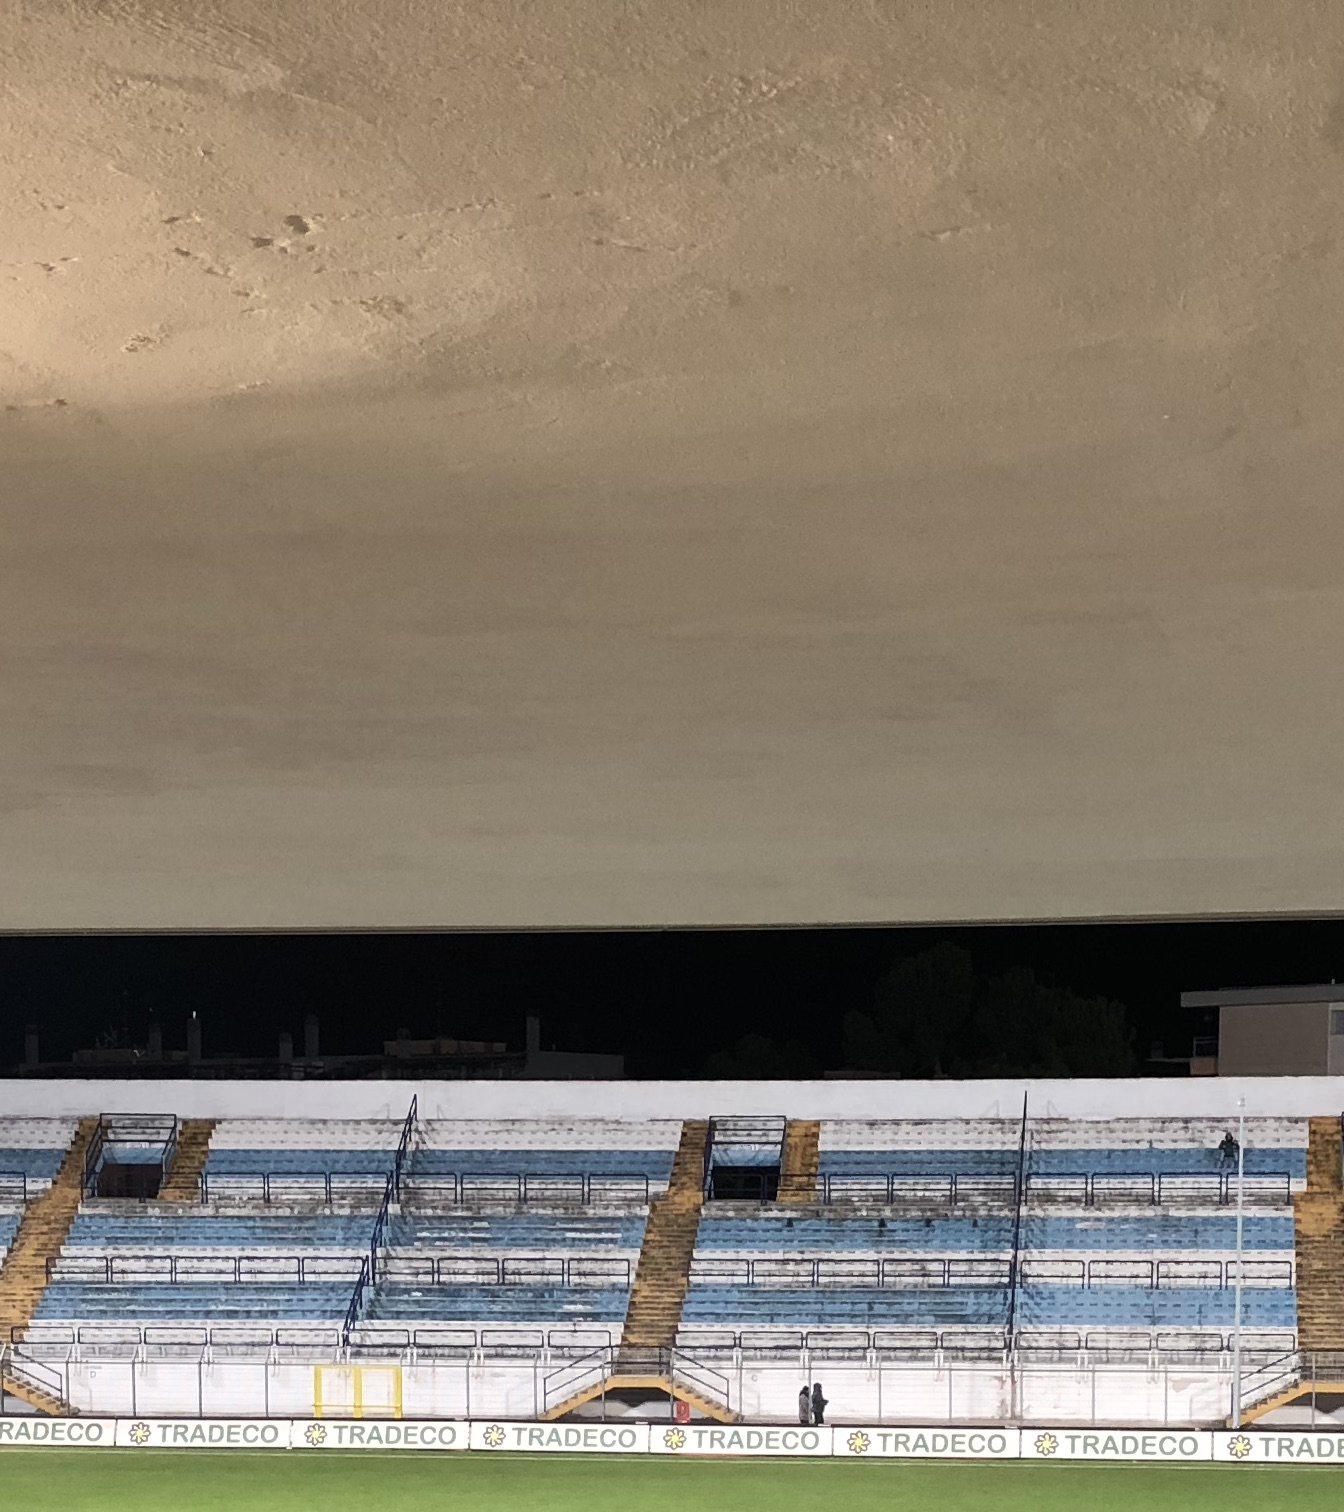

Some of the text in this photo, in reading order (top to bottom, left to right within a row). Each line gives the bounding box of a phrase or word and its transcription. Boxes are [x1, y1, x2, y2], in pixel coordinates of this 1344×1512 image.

[156, 1423, 279, 1444] TRADECO
[332, 1425, 457, 1445] TRADECO
[511, 1427, 637, 1448] TRADECO
[692, 1429, 820, 1451] TRADECO
[876, 1432, 1007, 1454] TRADECO
[1064, 1434, 1199, 1456] TRADECO
